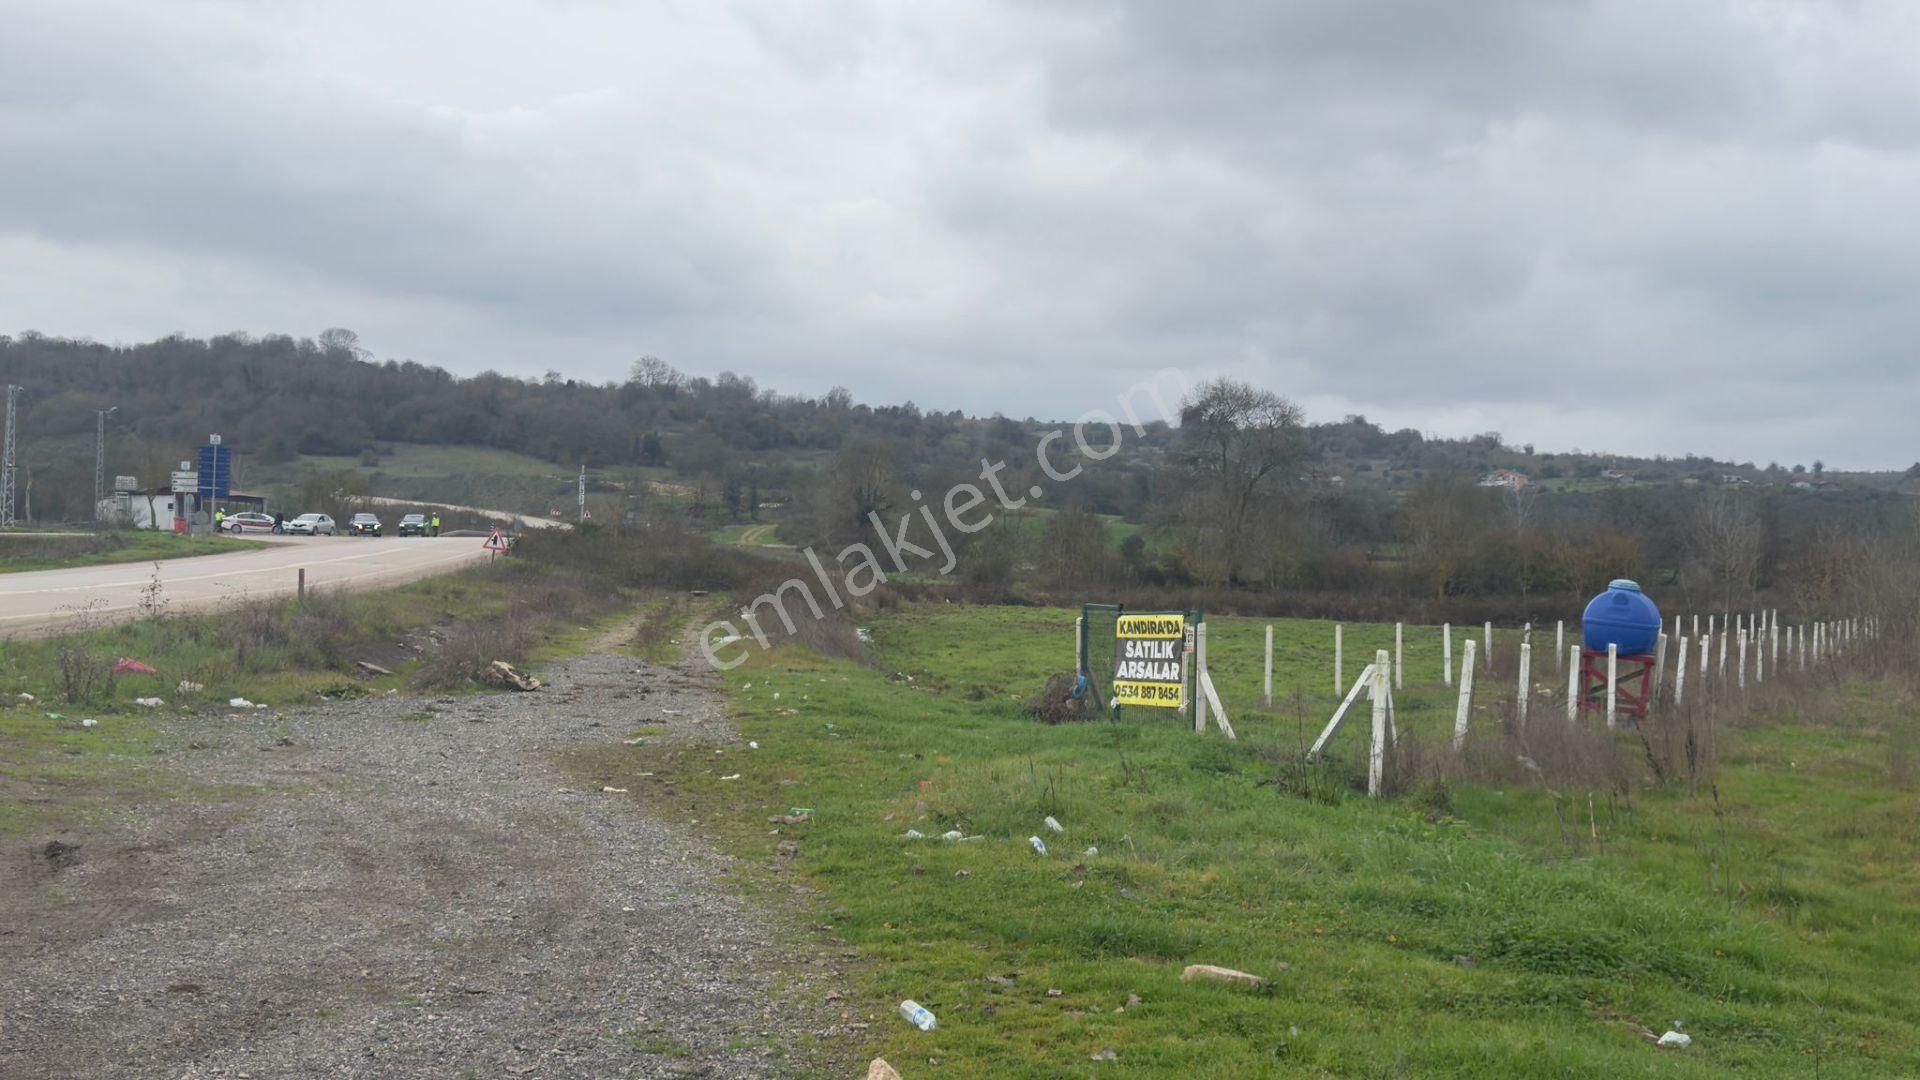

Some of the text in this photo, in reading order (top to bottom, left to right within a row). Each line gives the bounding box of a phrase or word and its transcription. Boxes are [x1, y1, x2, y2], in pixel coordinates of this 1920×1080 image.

[1119, 620, 1180, 635] KANDIRA'DA
[1125, 640, 1175, 659] SATILIK
[1116, 660, 1180, 680] ARSALAR
[1114, 684, 1179, 701] 0534 887 8454
